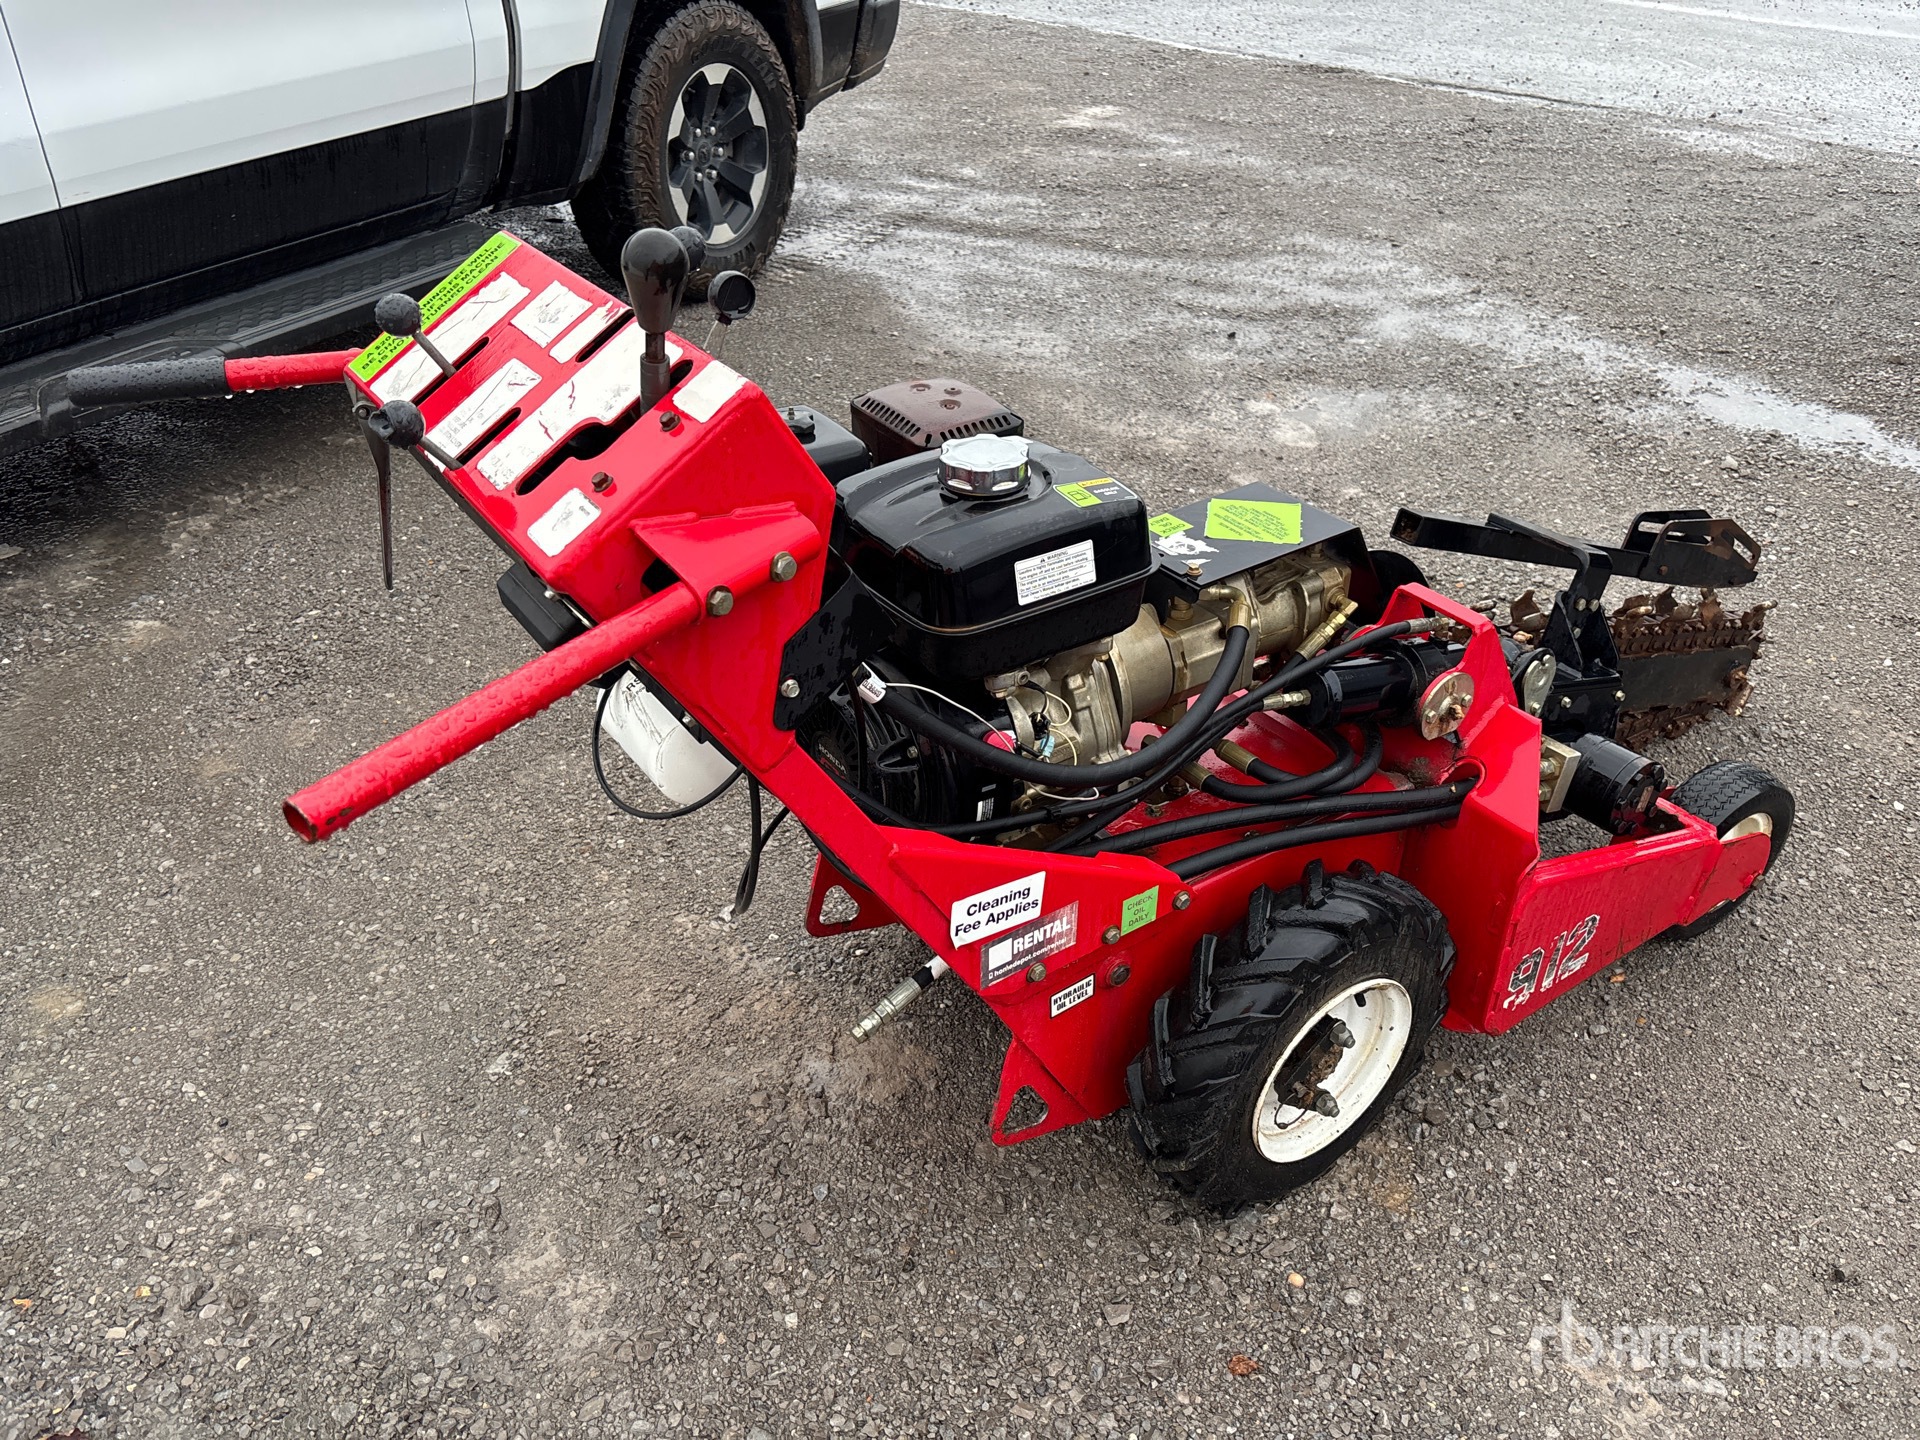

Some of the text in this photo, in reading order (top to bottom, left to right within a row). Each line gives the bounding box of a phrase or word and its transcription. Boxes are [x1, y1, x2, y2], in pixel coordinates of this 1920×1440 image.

[362, 357, 376, 370] BE
[426, 302, 435, 312] IF
[436, 282, 460, 302] THIS
[460, 242, 505, 282] MACHINE
[374, 336, 392, 351] $20
[448, 268, 467, 285] FEE
[466, 247, 492, 267] WILL
[378, 354, 388, 364] IS
[466, 256, 498, 285] CLEAN
[1160, 524, 1186, 534] CHECK
[1047, 550, 1068, 561] WARNING
[818, 742, 846, 774] HONDA
[966, 886, 1031, 916] Cleaning
[1127, 893, 1154, 912] CHECK
[1133, 906, 1146, 917] OIL
[954, 898, 1040, 937] Fee Applies
[1128, 911, 1150, 928] DAILY
[1013, 915, 1071, 954] RENTAL
[1506, 914, 1600, 1004] 912
[1053, 978, 1092, 1006] HYDRAULIC
[1056, 988, 1090, 1012] OIL LEVEL
